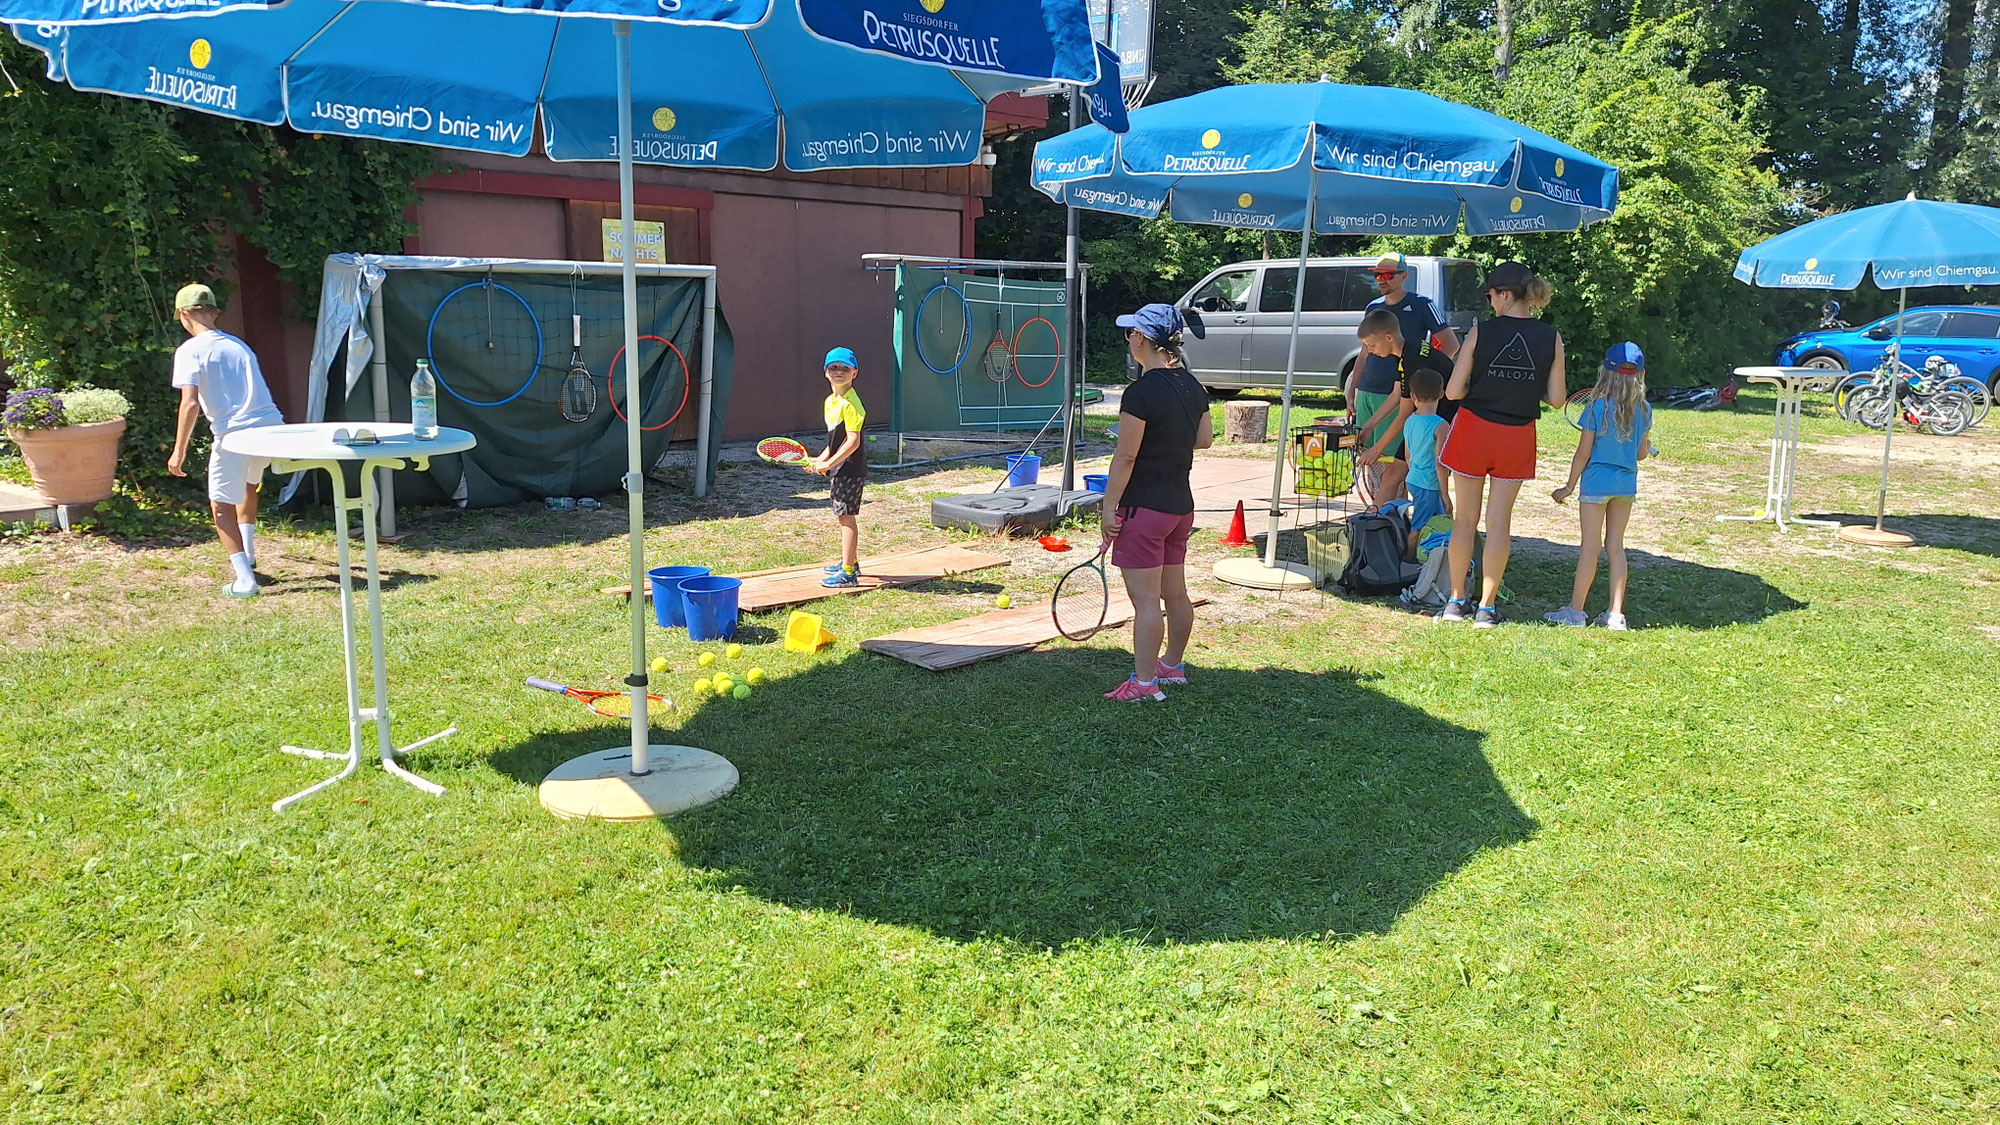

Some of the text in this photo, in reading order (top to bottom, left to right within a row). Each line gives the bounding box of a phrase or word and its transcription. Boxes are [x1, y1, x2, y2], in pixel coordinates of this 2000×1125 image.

[902, 12, 960, 32] SIEGSDORFER
[863, 9, 1006, 70] PETRUSQUELLE
[1038, 157, 1057, 174] Wir
[1055, 157, 1077, 174] sind
[1163, 153, 1252, 173] PETRUSQUELLE
[1326, 143, 1500, 178] Wir sind Chiemgau.
[609, 231, 662, 246] SOMER
[610, 247, 658, 260] NAHTS
[1780, 272, 1836, 286] PETRUSQUELLE
[1881, 264, 1999, 280] Wir sind Chiemgau.
[1487, 369, 1535, 381] MALOJA
